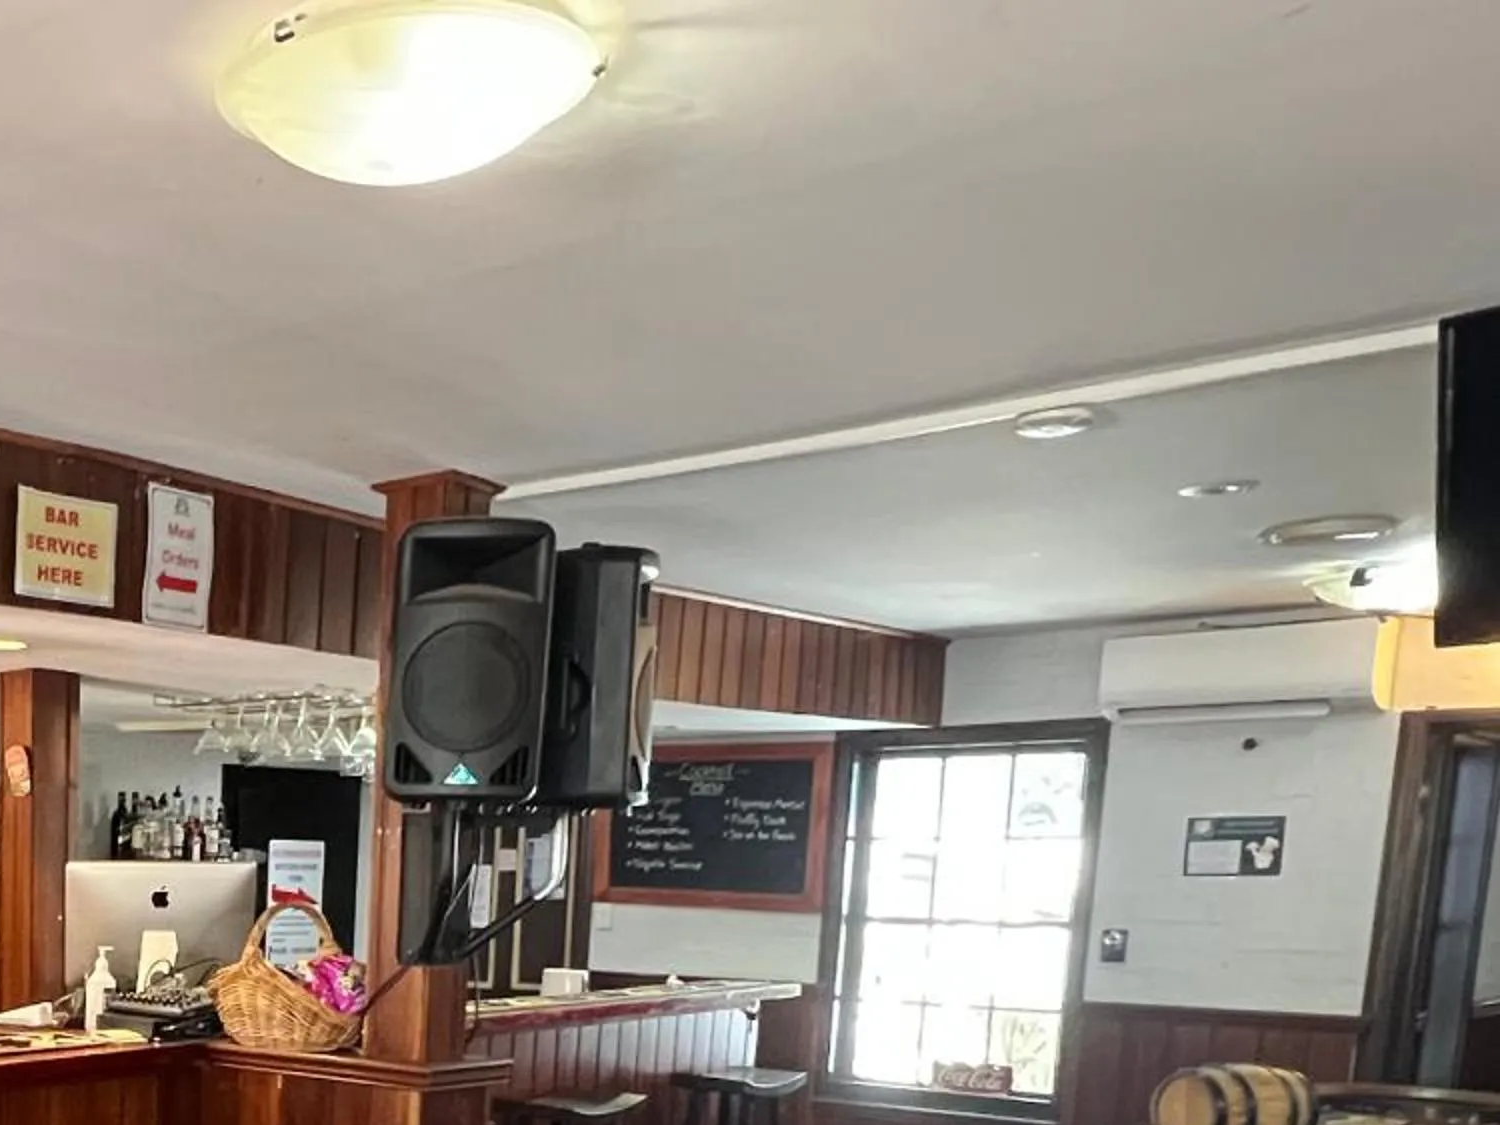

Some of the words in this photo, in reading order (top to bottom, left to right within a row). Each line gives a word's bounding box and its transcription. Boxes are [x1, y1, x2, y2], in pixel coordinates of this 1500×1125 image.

[45, 506, 79, 527] BAR
[167, 521, 195, 539] Meal
[26, 532, 98, 559] SERVICE
[161, 549, 199, 570] Orders
[37, 564, 84, 586] HERE
